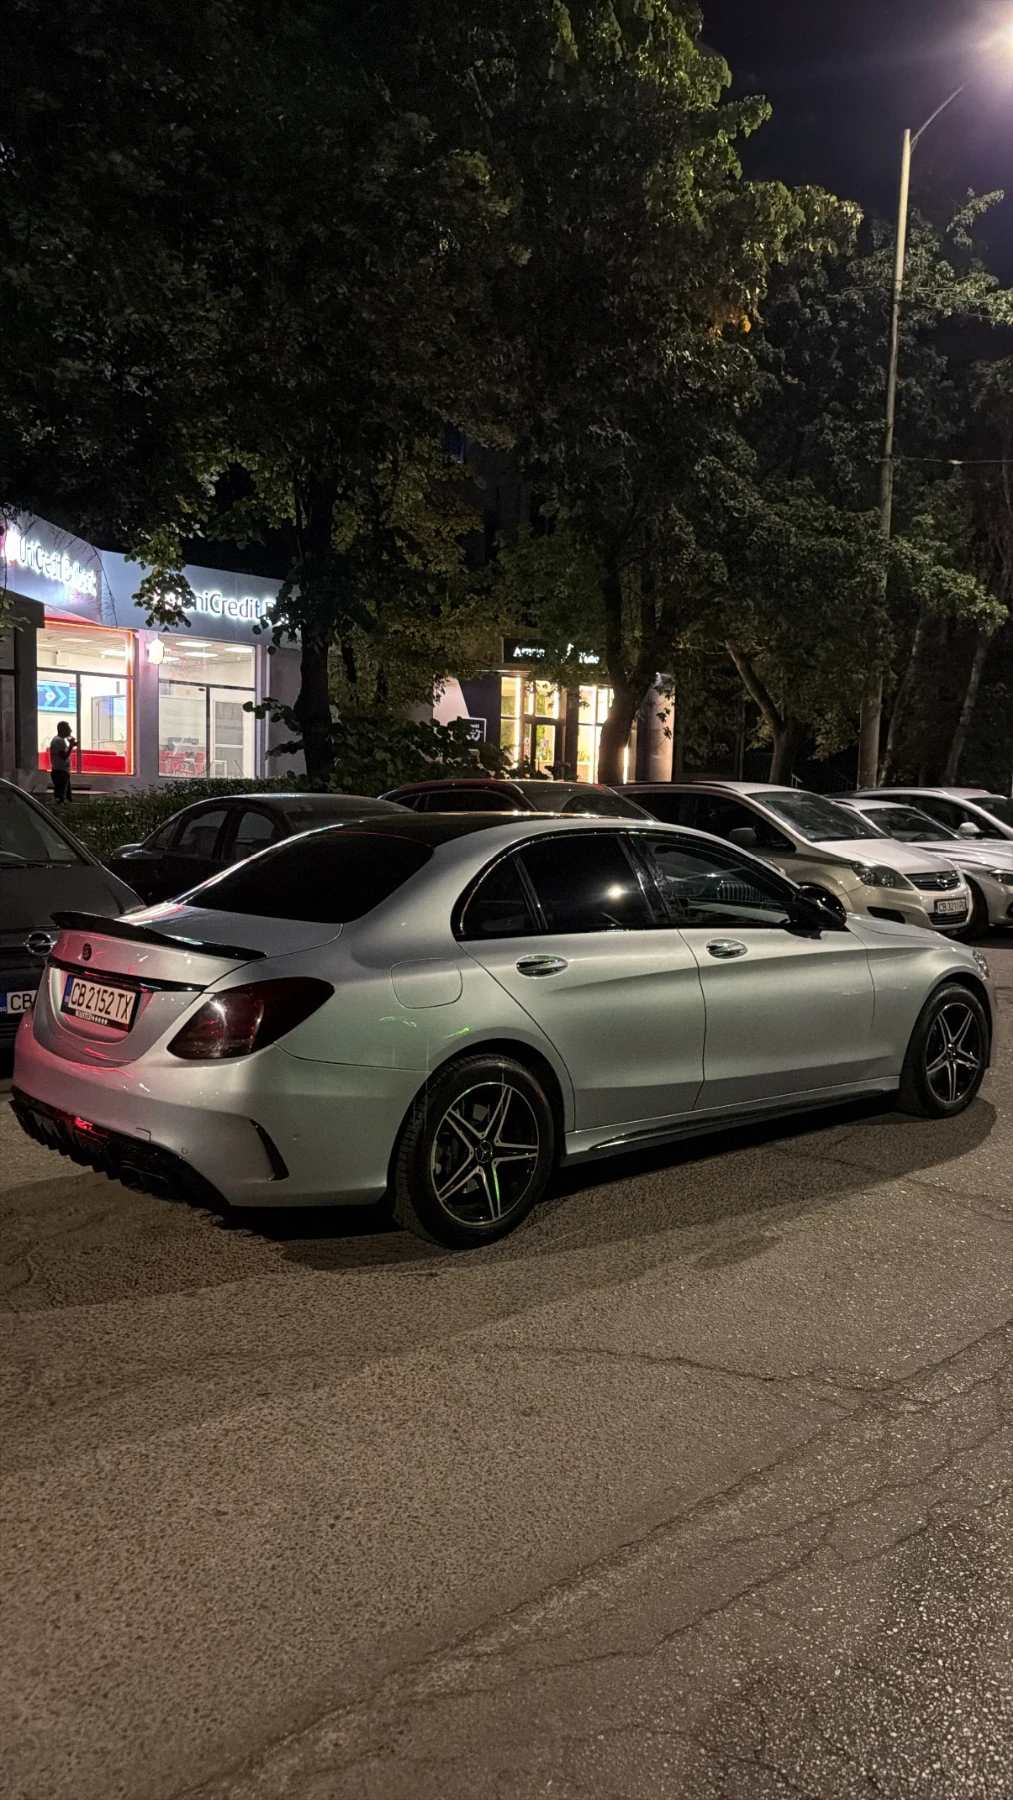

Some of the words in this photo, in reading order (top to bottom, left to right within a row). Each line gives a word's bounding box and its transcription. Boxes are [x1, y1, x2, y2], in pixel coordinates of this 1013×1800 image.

[185, 592, 261, 619] niCredit
[10, 993, 33, 1011] CB
[70, 982, 87, 1007] CB
[85, 986, 115, 1016] 2152
[115, 993, 133, 1020] TX
